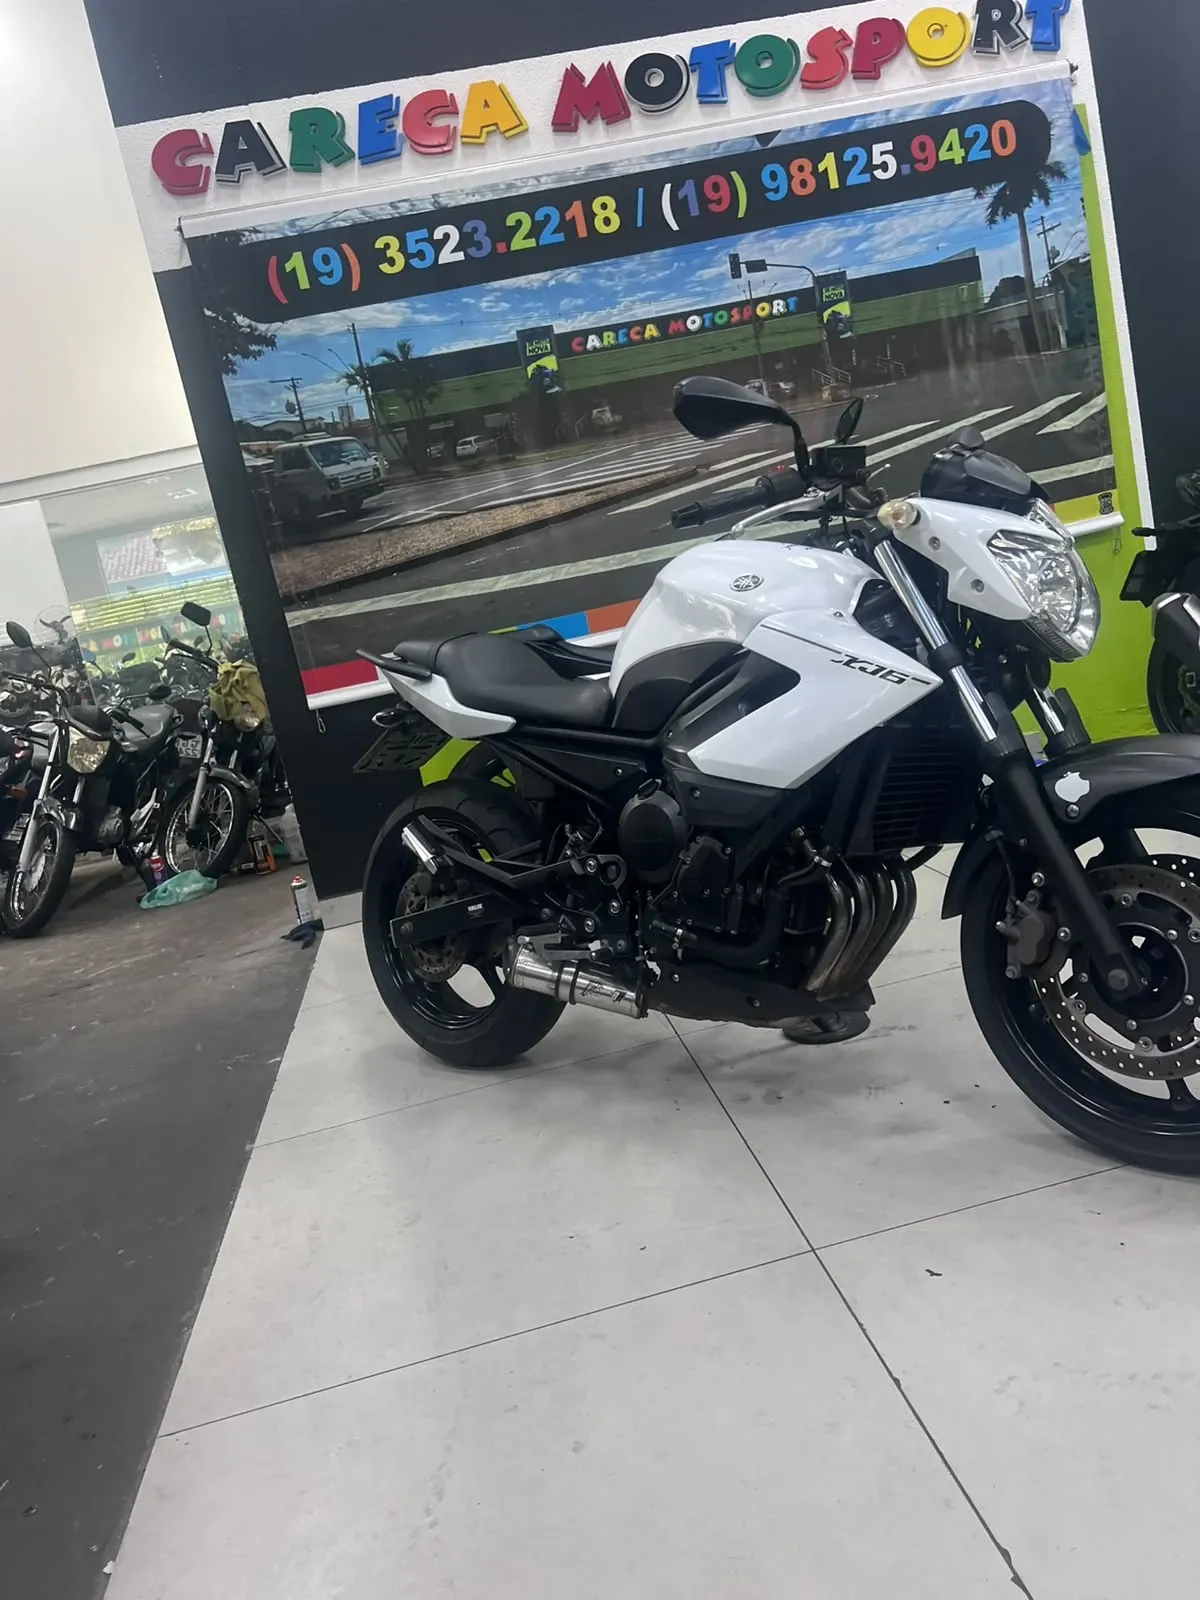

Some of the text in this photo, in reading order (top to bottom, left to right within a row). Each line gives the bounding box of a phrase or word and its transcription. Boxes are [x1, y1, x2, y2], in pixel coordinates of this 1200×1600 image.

[151, 0, 1071, 195] CARECA MOTOSPORT
[268, 243, 361, 304] (19)
[374, 195, 621, 275] 3523.2218
[661, 170, 748, 231] (19)
[761, 119, 1016, 200] 98125.9420
[571, 296, 798, 353] CARECA MOTOSPORT
